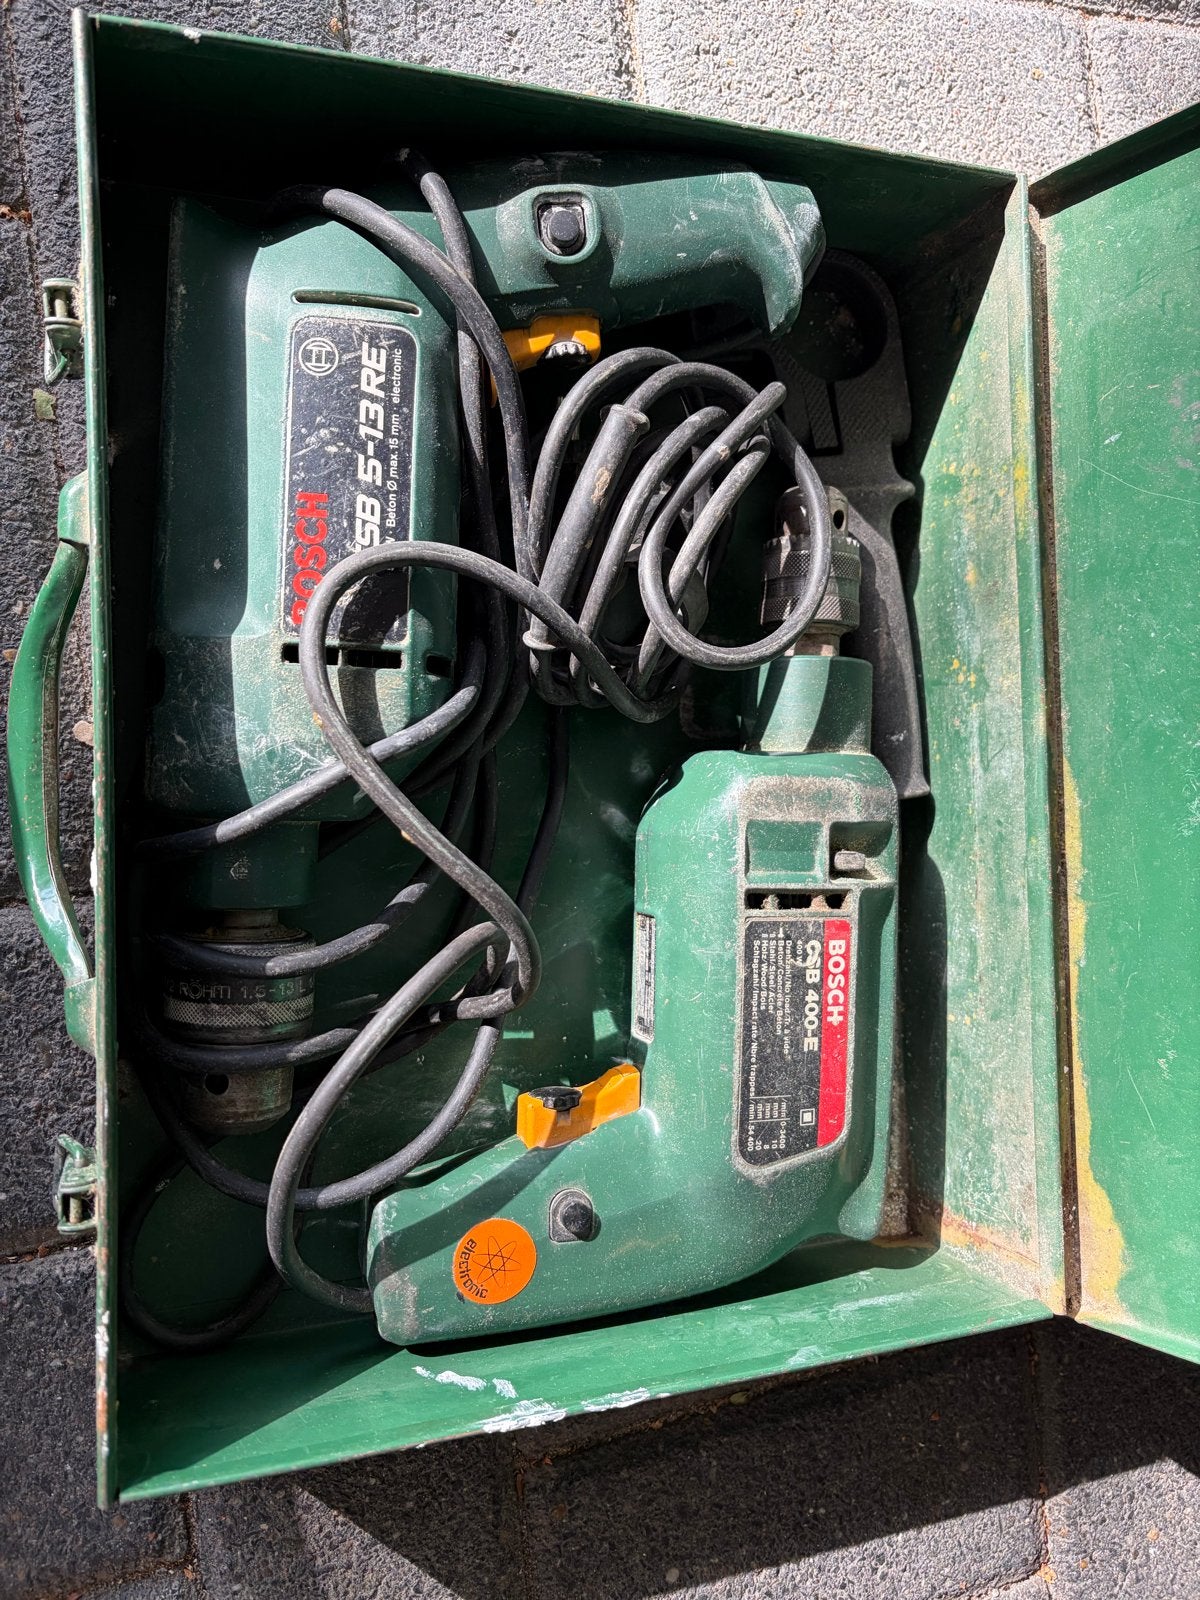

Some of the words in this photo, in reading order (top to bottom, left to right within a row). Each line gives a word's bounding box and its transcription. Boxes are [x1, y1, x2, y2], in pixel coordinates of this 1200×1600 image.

[360, 341, 387, 398] RE
[390, 348, 402, 403] electronic
[357, 399, 384, 486] 5-13
[391, 414, 400, 435] mm
[355, 494, 381, 551] SB
[386, 494, 397, 527] Beton
[751, 940, 760, 1020] Schlagzahl/Impact
[760, 940, 768, 1011] Holz/Wood/Bois
[768, 940, 776, 1014] Stahl/Steel/Acier
[805, 939, 821, 984] CSB
[827, 939, 846, 1023] BOSCH
[750, 1021, 758, 1064] rate/Nbre
[804, 989, 819, 1052] 400-E
[783, 1036, 791, 1054] vide
[749, 1064, 757, 1096] frappes
[757, 1104, 763, 1119] mm
[765, 1103, 771, 1118] mm
[773, 1102, 779, 1118] mm
[755, 1140, 762, 1150] 20
[771, 1140, 778, 1149] 10
[779, 1121, 787, 1149] 0-3400
[459, 1238, 488, 1298] electronic
